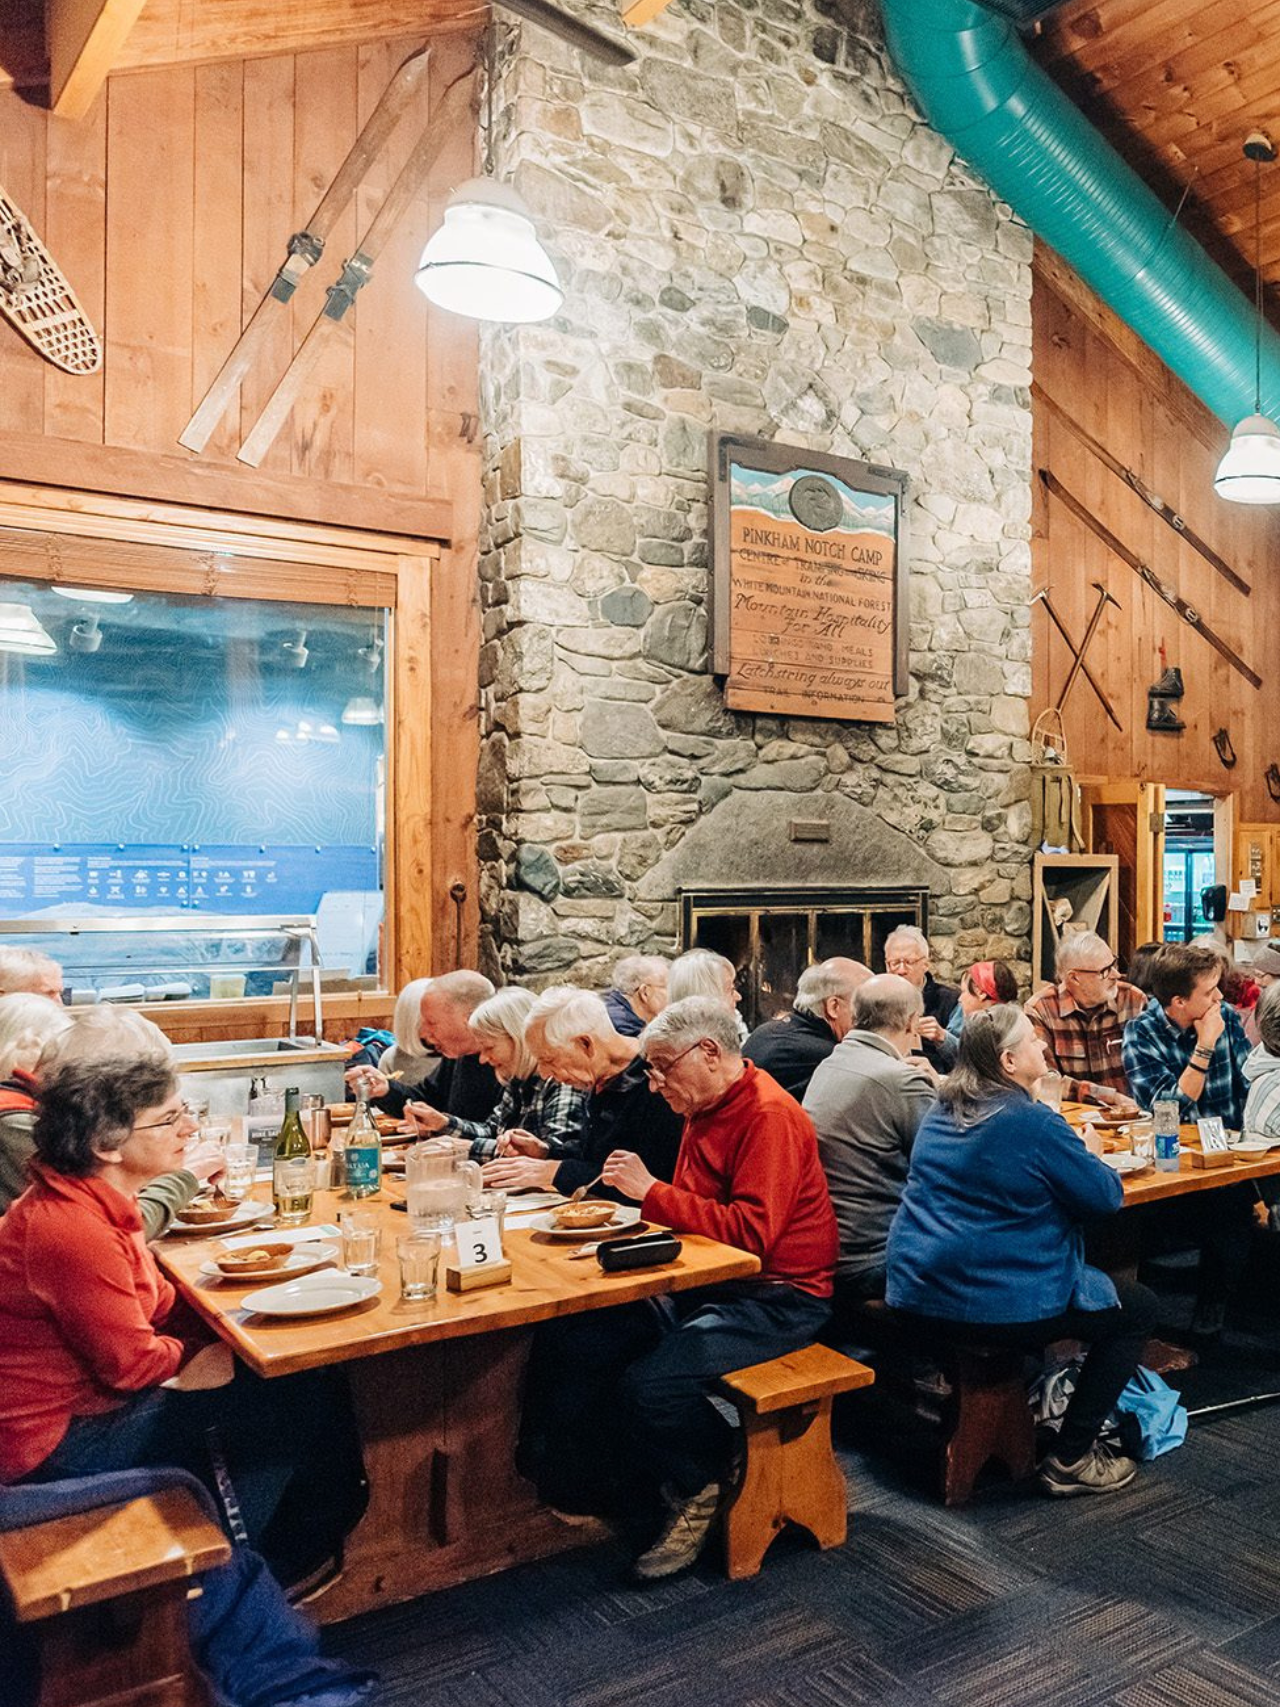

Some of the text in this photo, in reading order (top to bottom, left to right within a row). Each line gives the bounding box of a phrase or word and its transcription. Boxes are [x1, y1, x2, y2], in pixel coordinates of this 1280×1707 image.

[739, 548, 781, 566] CENTRE
[743, 527, 883, 566] PINKHAM NOTCH CAMP
[800, 574, 811, 584] in
[732, 578, 892, 612] WHITE MOUNTAIN NATIONAL FOREST
[734, 592, 892, 635] Mountain Hospitality
[782, 616, 846, 638] for All
[804, 651, 824, 662] AND
[829, 654, 873, 668] SUPPLIES
[841, 645, 873, 657] MEALS
[737, 662, 890, 691] Latchstring always out
[473, 1243, 488, 1263] 3
